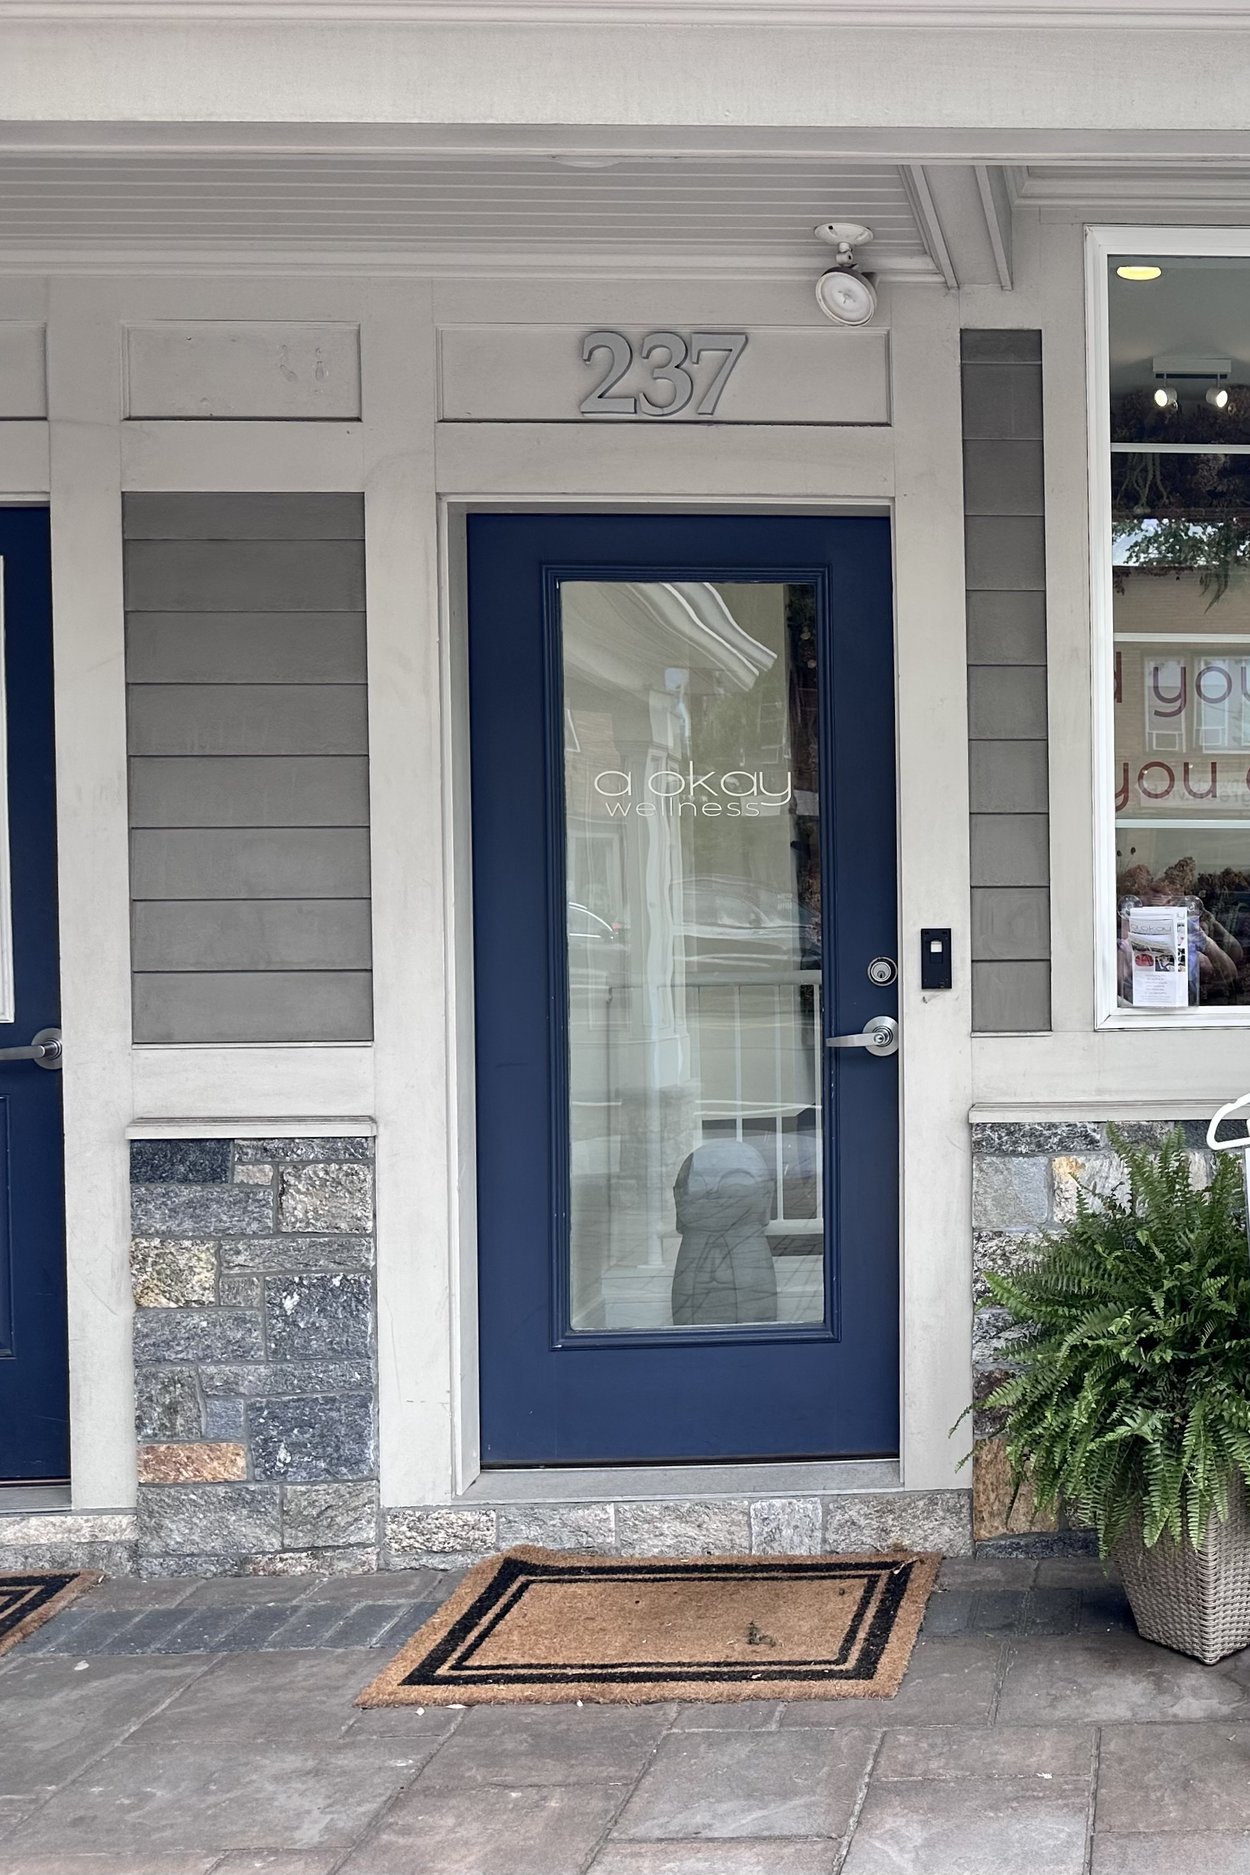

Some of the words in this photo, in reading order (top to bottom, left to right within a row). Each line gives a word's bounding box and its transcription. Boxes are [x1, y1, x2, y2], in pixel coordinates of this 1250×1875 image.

[580, 330, 748, 417] 237
[594, 770, 632, 796] a
[648, 761, 792, 806] okay
[605, 797, 760, 817] wellness
